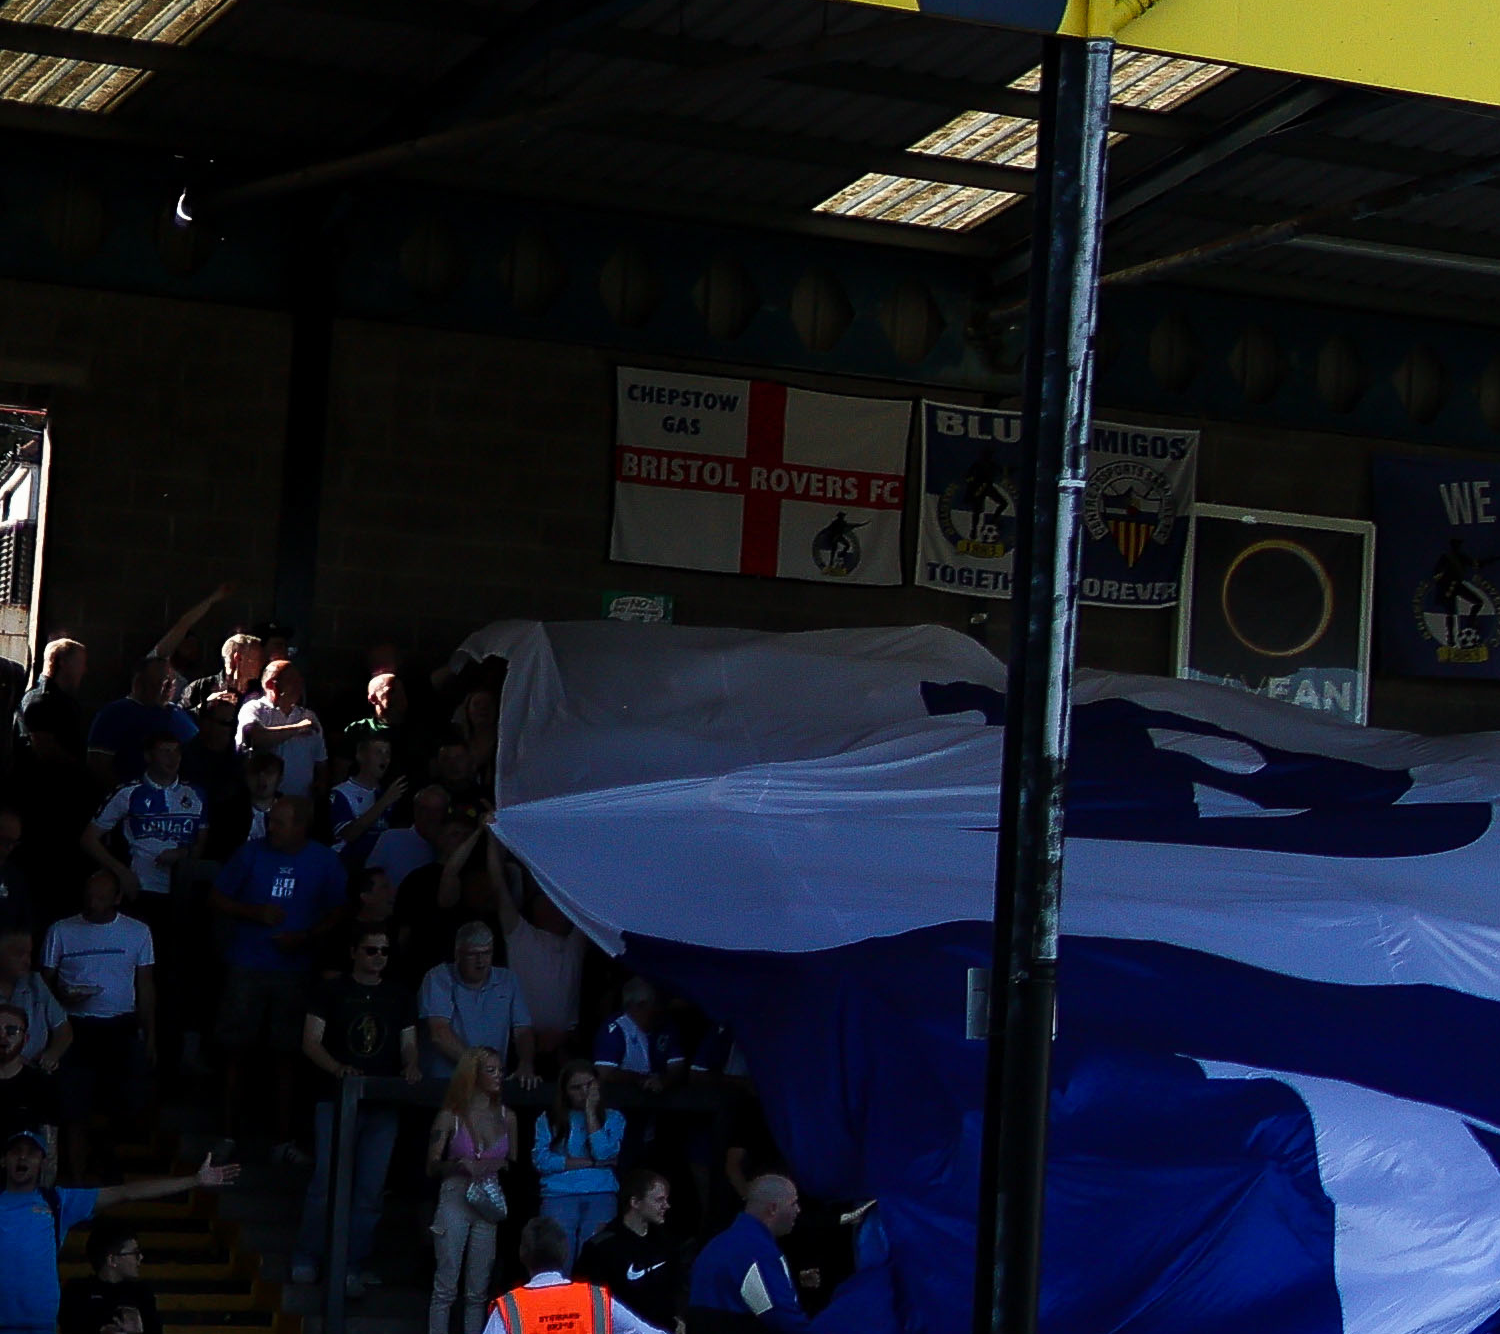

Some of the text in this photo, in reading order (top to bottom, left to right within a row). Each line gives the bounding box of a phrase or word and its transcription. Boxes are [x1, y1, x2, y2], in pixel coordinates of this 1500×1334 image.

[628, 384, 739, 413] CHEPSTOW
[662, 416, 700, 435] GAS
[936, 410, 1023, 443] BLU
[1089, 429, 1188, 460] MIGOS
[621, 453, 900, 504] BRISTOL ROVERS FC
[1439, 480, 1497, 526] WE
[927, 561, 1178, 601] TOGETH OREVER
